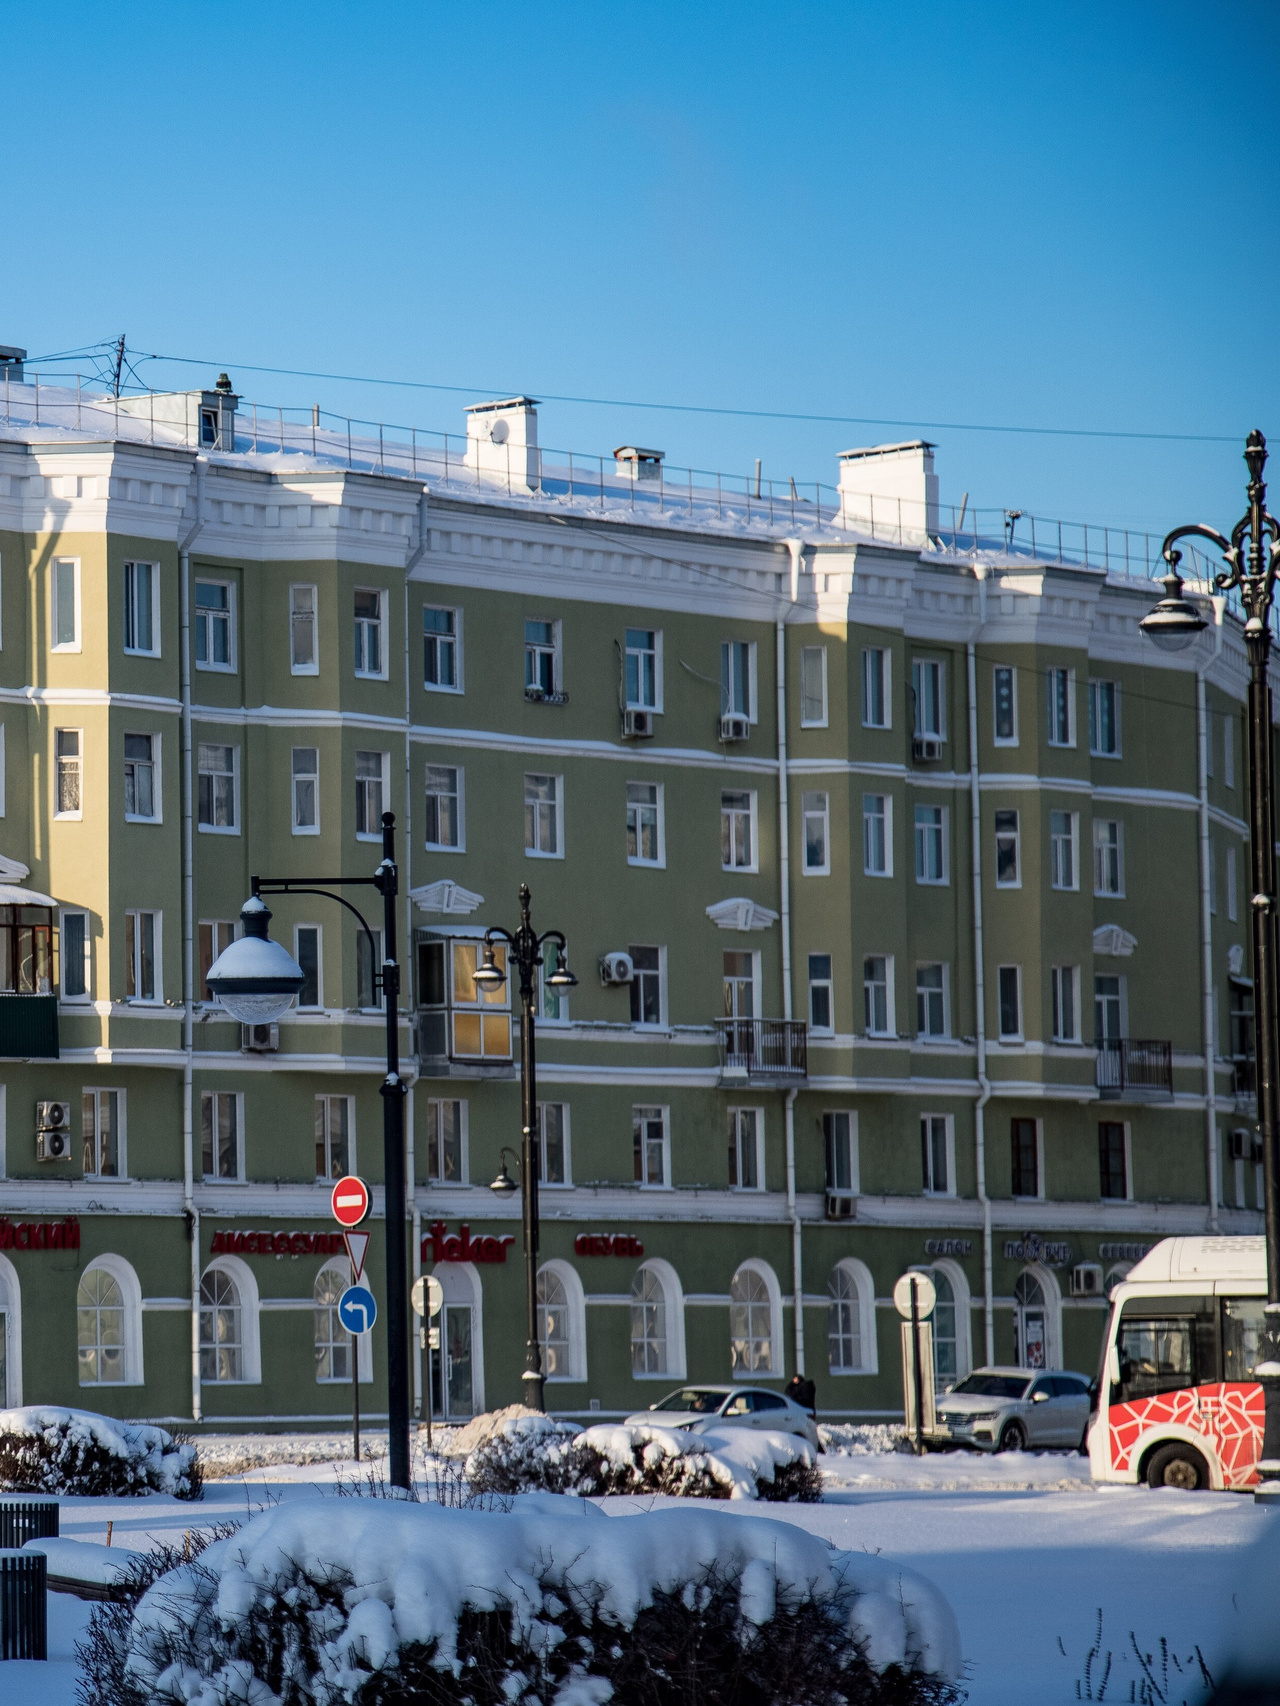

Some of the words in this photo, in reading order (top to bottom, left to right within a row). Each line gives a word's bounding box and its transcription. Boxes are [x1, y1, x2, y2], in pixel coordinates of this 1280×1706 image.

[210, 1231, 349, 1254] АКСЕССУАР
[421, 1220, 516, 1263] rieker
[574, 1234, 644, 1258] ОБУВЬ
[925, 1239, 973, 1255] САЛОН
